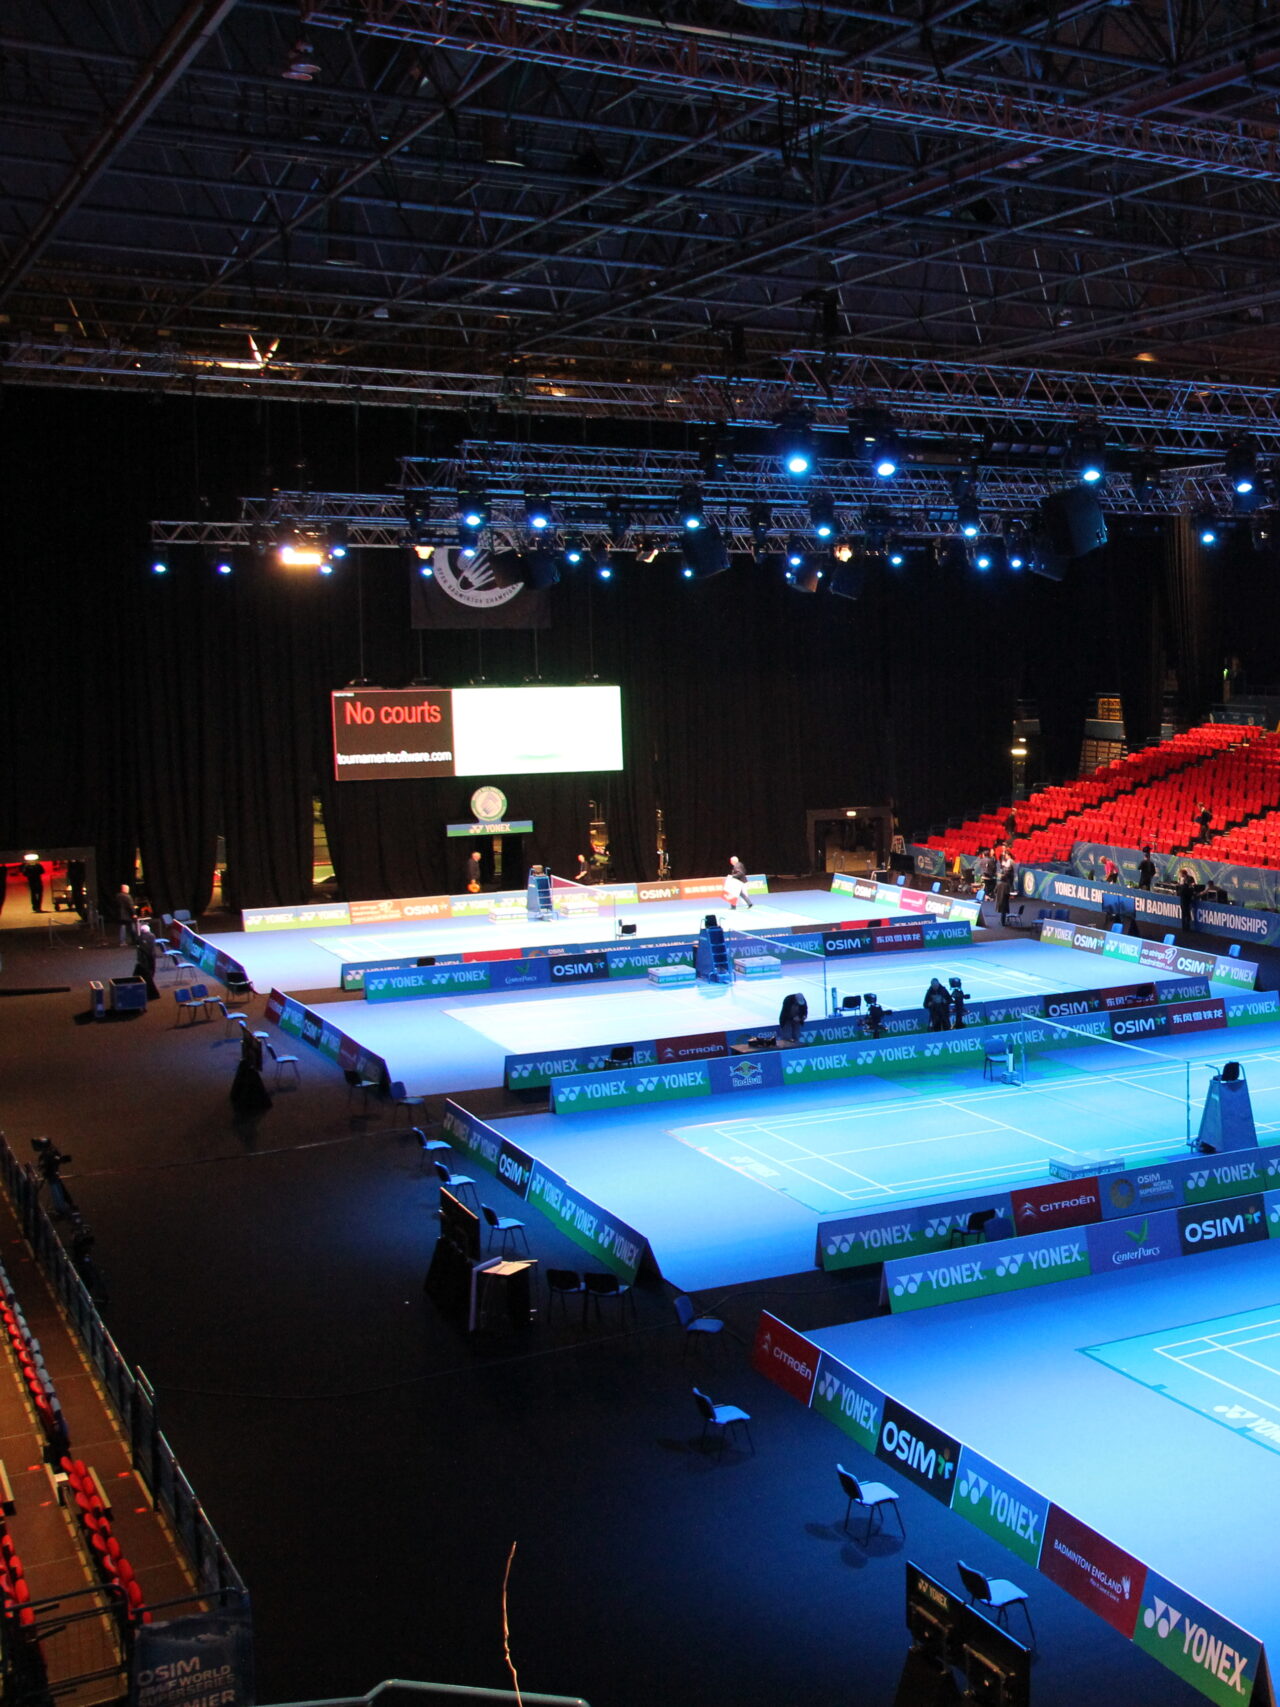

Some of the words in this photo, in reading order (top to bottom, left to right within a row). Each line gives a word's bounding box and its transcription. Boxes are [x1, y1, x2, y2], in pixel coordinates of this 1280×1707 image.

[345, 701, 375, 725] No
[380, 701, 442, 724] courts
[640, 888, 672, 900] OSIM
[403, 904, 439, 916] OSIM
[1054, 881, 1076, 898] YONEX
[1076, 884, 1090, 900] ALL
[1196, 908, 1268, 935] CHAMPIONSHIPS
[942, 928, 968, 938] YONEX
[1054, 928, 1072, 940] YONEX
[1074, 933, 1098, 950] OSIM
[826, 938, 861, 950] OSIM
[1118, 942, 1139, 958] YONEX
[629, 954, 660, 966] YONEX
[1177, 957, 1205, 974] OSIM
[452, 970, 487, 983] YONEX
[552, 962, 594, 977] OSIM
[1230, 966, 1254, 982] YONEX
[390, 975, 425, 988] YONEX
[1178, 986, 1208, 997] YONEX
[1008, 1004, 1040, 1020] YONEX
[1048, 1000, 1089, 1018] OSIM
[1246, 999, 1278, 1015] YONEX
[820, 1026, 856, 1041] YONEX
[1074, 1020, 1109, 1036] YONEX
[1114, 1016, 1156, 1035] OSIM
[1010, 1030, 1045, 1044] YONEX
[678, 1044, 725, 1057] CITROËN
[878, 1046, 917, 1062] YONEX
[946, 1038, 983, 1054] YONEX
[536, 1059, 579, 1075] YONEX
[810, 1054, 849, 1070] YONEX
[662, 1072, 705, 1089] YONEX
[584, 1081, 628, 1098] YONEX
[498, 1153, 523, 1188] OSIM
[1137, 1173, 1161, 1185] OSIM
[1212, 1162, 1259, 1185] YONEX
[542, 1178, 565, 1211] YONEX
[1040, 1194, 1096, 1214] CITROËN
[573, 1203, 599, 1240] YONEX
[1184, 1214, 1245, 1243] OSIM
[859, 1223, 914, 1250] YONEX
[611, 1230, 640, 1271] YONEX
[1027, 1243, 1084, 1270] YONEX
[1112, 1246, 1160, 1265] CenterParcs
[926, 1262, 987, 1290] YONEX
[773, 1346, 812, 1380] CITROËN
[839, 1383, 879, 1434] YONEX
[882, 1420, 936, 1480] OSIM
[988, 1484, 1040, 1545] YONEX
[1054, 1538, 1092, 1574] BADMINTON
[1090, 1564, 1123, 1595] ENGLAND
[1182, 1616, 1248, 1695] YONEX
[136, 1656, 201, 1687] OSIM
[178, 1664, 232, 1687] WORLD
